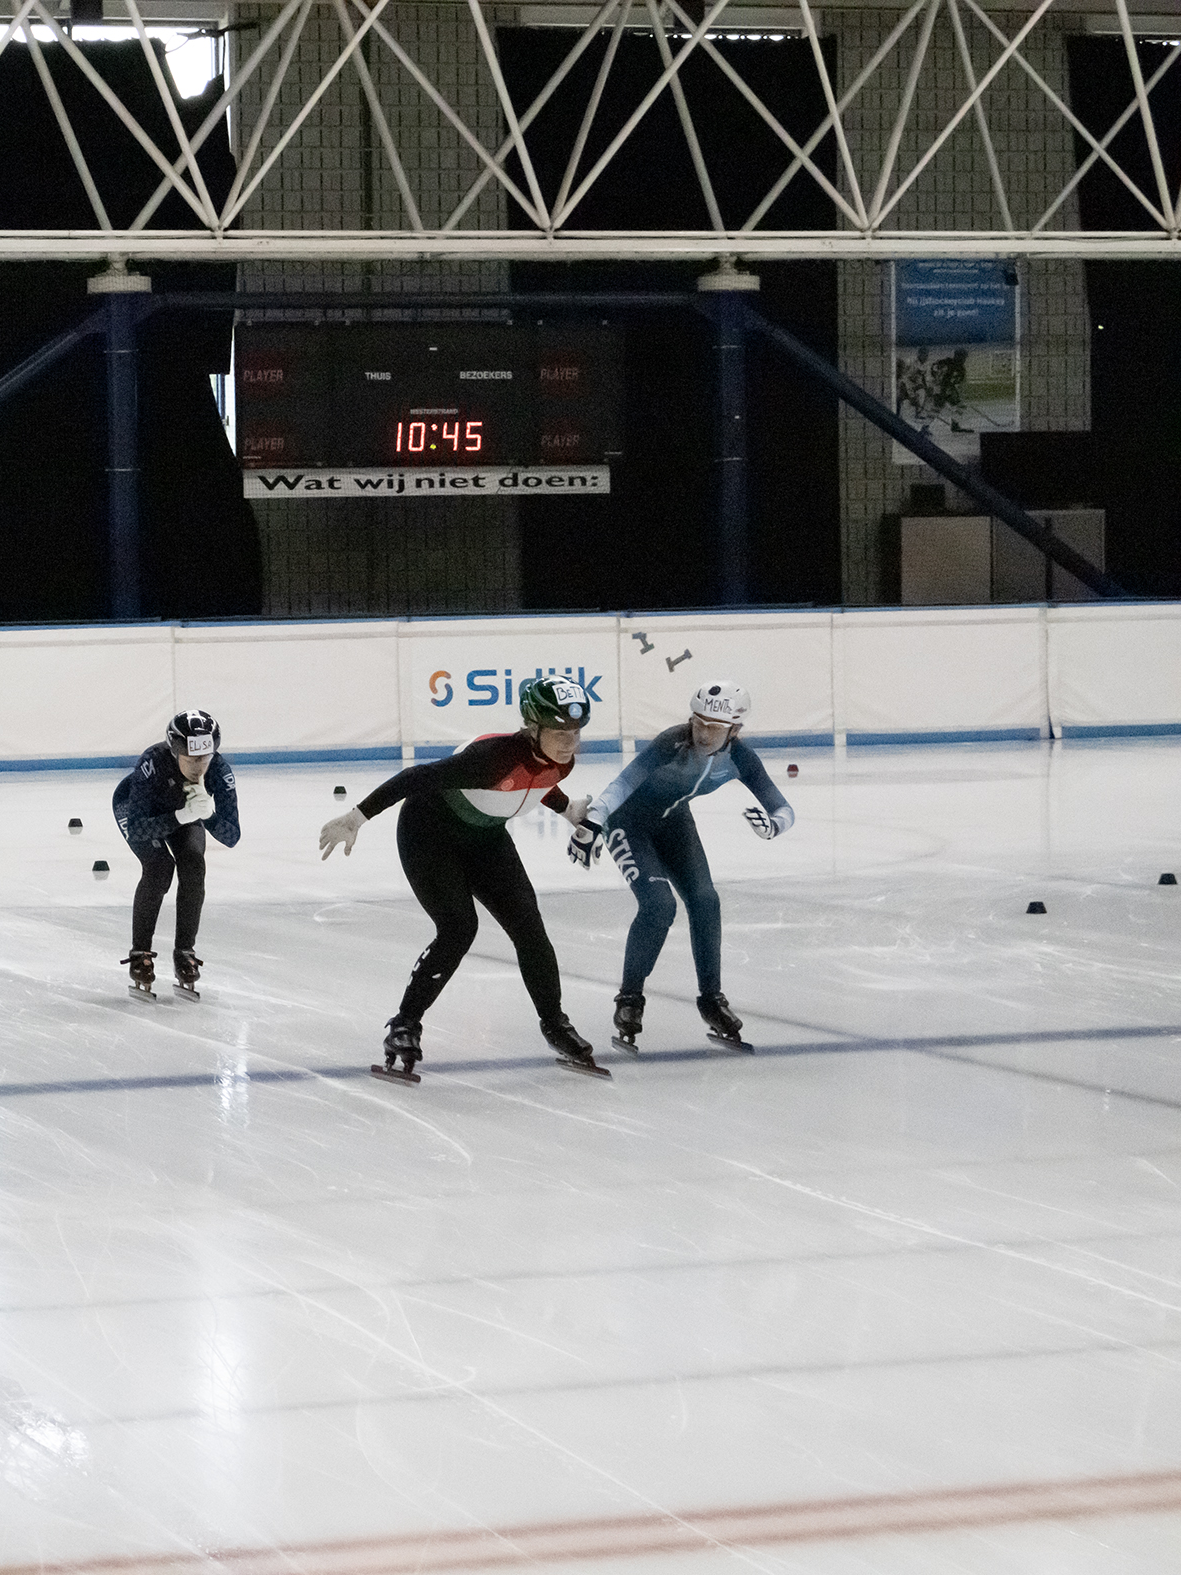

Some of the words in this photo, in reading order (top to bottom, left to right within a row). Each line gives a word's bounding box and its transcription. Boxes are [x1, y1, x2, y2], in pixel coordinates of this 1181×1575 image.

[243, 369, 283, 382] PLAYER
[365, 371, 391, 381] THUIS
[459, 370, 513, 380] BEZOEKERS
[395, 421, 483, 452] 10:45
[244, 437, 285, 451] PLAYER
[257, 474, 342, 491] Wat
[354, 473, 405, 494] wij
[415, 472, 487, 489] niet
[498, 472, 599, 488] doen:
